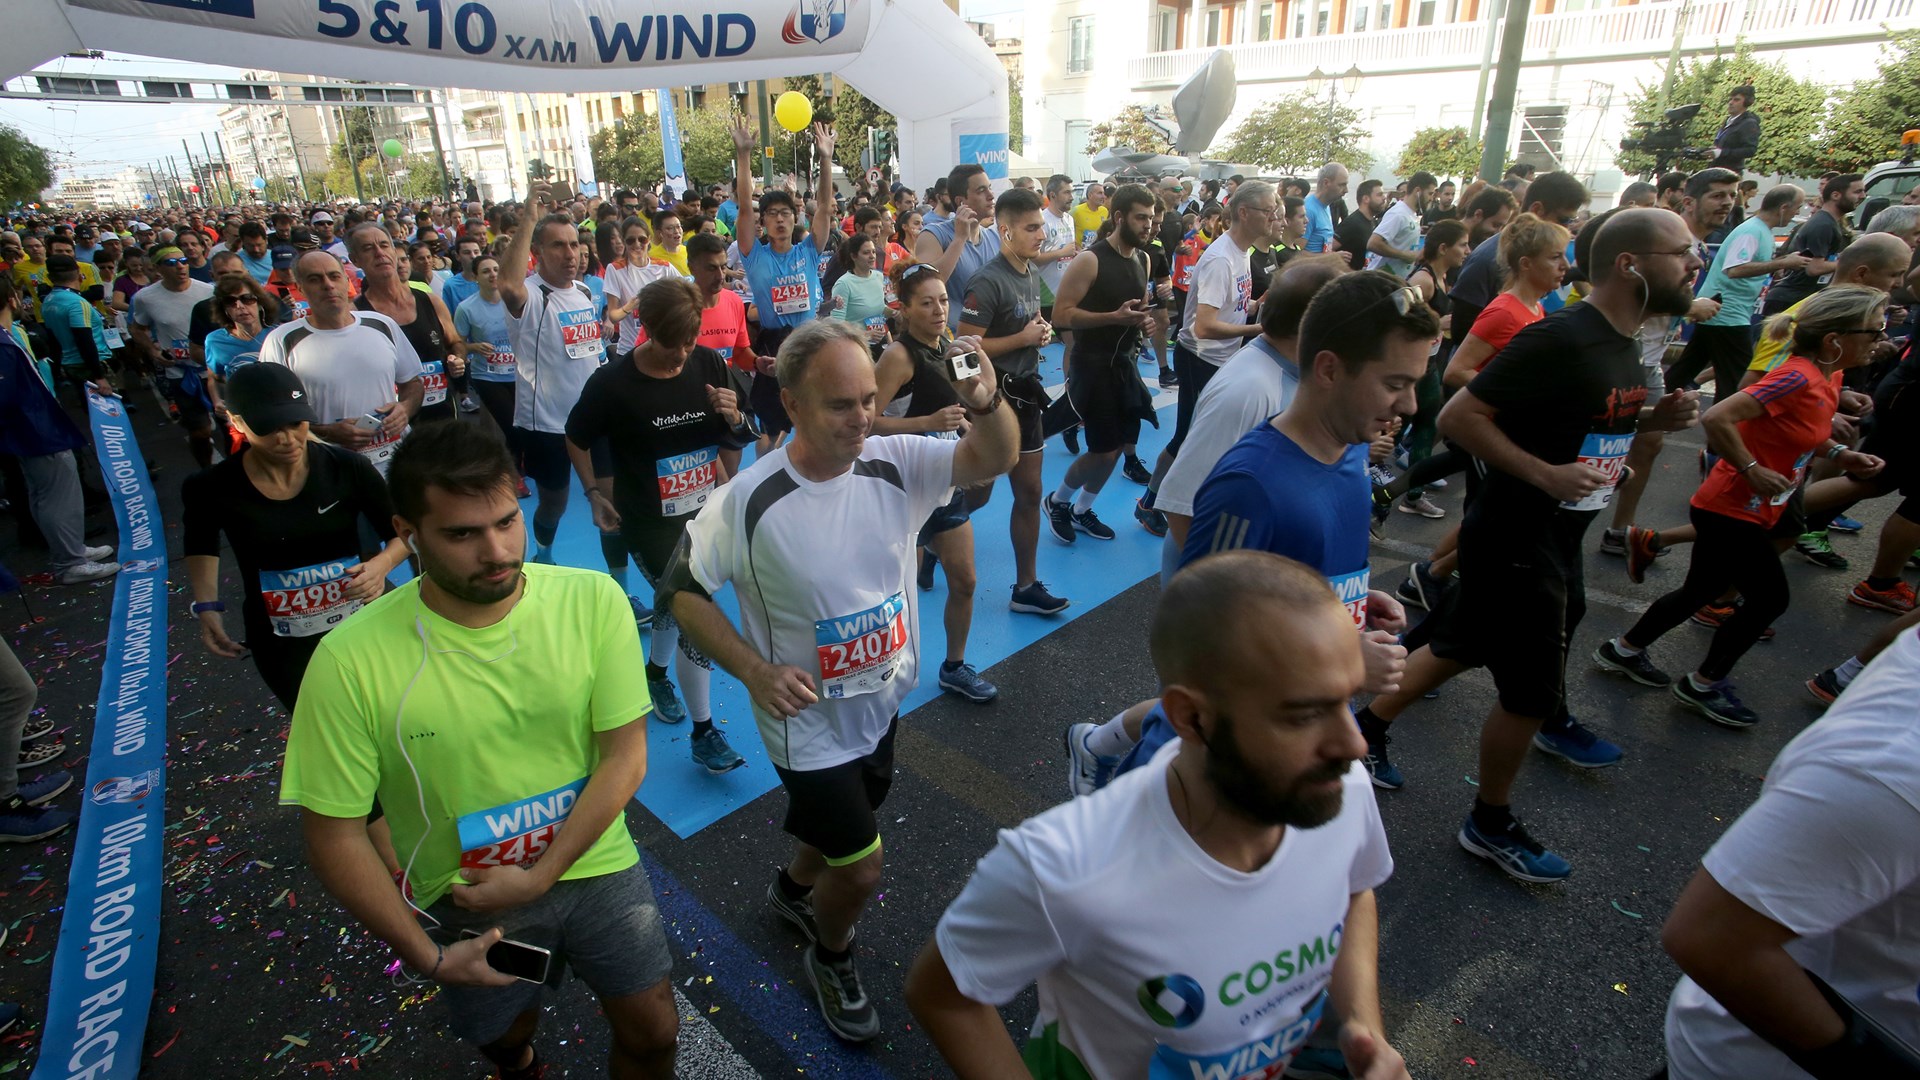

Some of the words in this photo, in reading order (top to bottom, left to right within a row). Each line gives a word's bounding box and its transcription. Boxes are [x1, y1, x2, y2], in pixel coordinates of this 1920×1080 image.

[590, 12, 756, 63] WIND
[975, 150, 1007, 164] WIND
[775, 284, 809, 300] 2432
[776, 272, 806, 285] WIND
[568, 311, 593, 323] WIND
[569, 322, 597, 340] 24179
[490, 352, 515, 363] 2437
[494, 344, 512, 352] WIN
[101, 423, 127, 458] 10km
[936, 429, 960, 440] WIN
[1599, 436, 1634, 455] WIN
[112, 459, 140, 495] ROAD
[668, 450, 708, 473] WIND
[666, 464, 713, 495] 25432
[124, 494, 149, 528] RACE
[132, 522, 153, 551] WIND
[278, 562, 345, 588] WIND
[1329, 571, 1370, 602] WIN
[128, 577, 154, 620] ΑΓΩΝΑΣ
[834, 602, 895, 640] WIND
[121, 617, 153, 668] ΔΡΟΜΟΥ
[831, 613, 900, 672] 24077
[113, 705, 148, 756] WIND
[485, 789, 577, 839] WIND
[96, 813, 147, 888] 10km
[85, 883, 136, 981] ROAD
[1189, 1018, 1311, 1080] WIND
